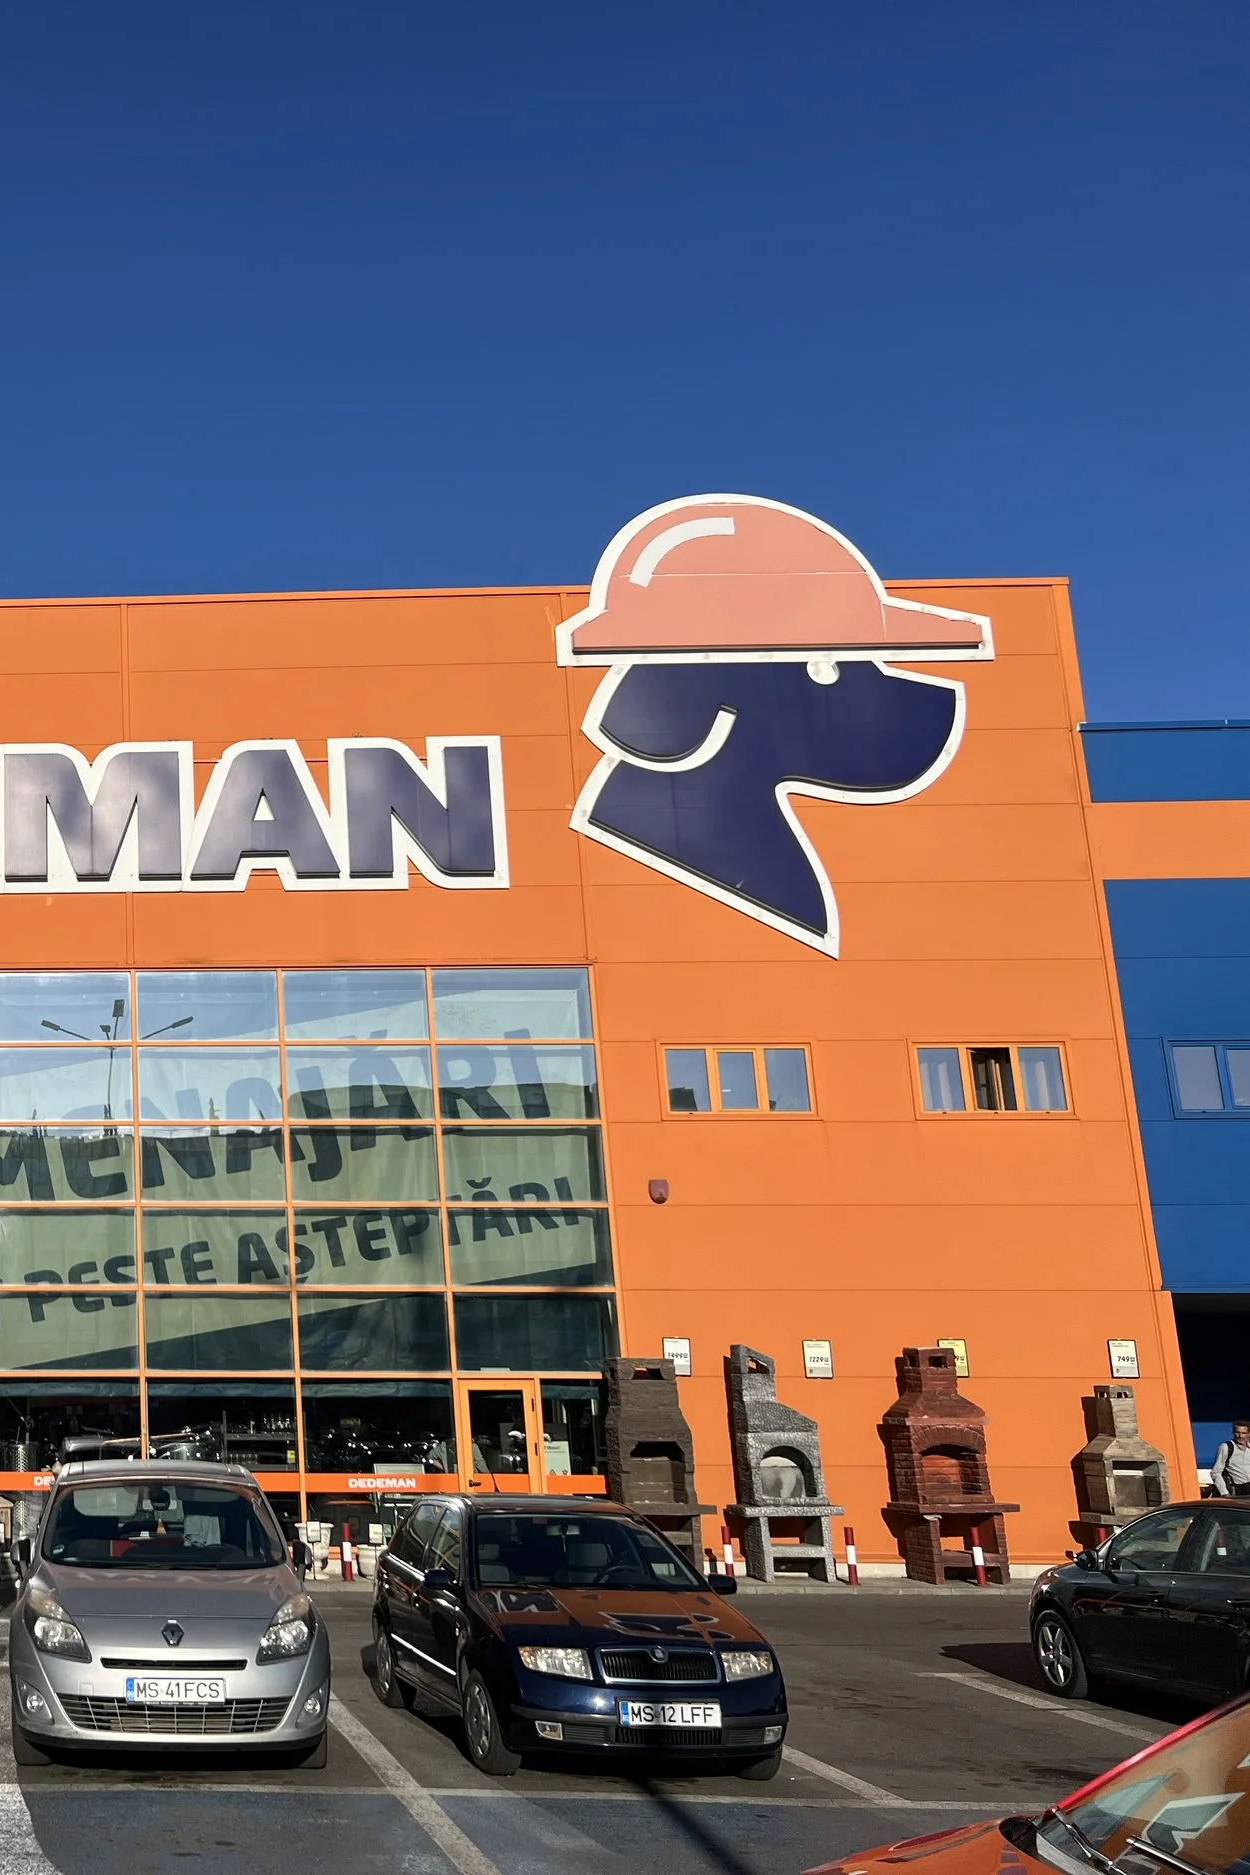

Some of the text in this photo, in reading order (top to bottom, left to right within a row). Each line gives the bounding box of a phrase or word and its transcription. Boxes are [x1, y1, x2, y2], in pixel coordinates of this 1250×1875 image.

[24, 1240, 217, 1322] PESTE
[348, 1478, 417, 1488] DEDEMAN
[136, 1682, 159, 1698] MS
[631, 1706, 654, 1722] MS
